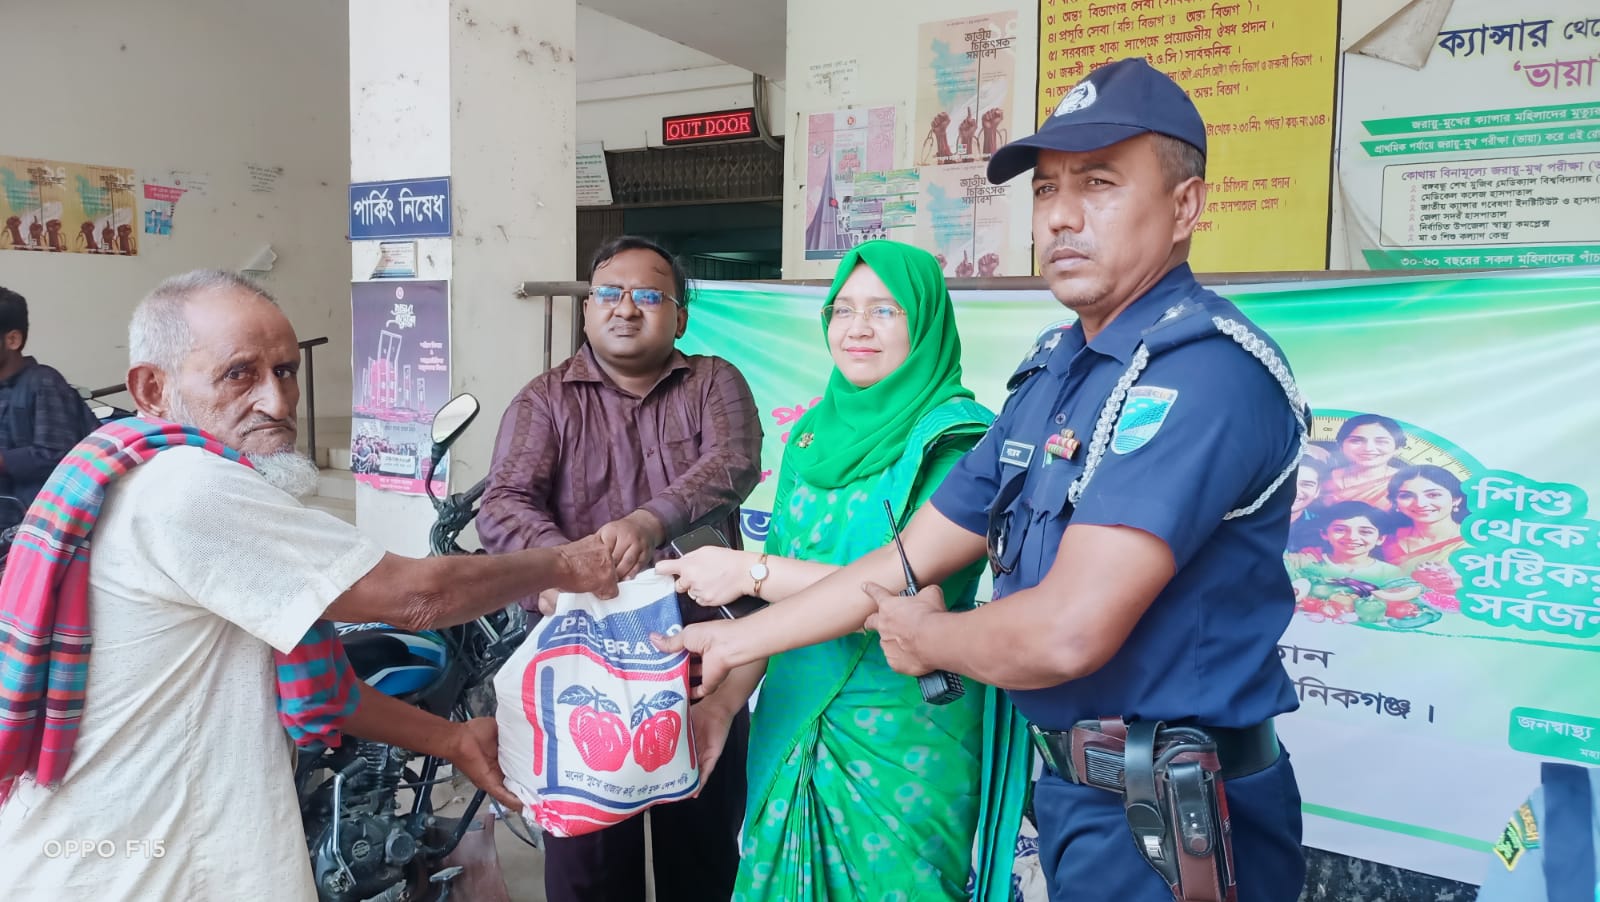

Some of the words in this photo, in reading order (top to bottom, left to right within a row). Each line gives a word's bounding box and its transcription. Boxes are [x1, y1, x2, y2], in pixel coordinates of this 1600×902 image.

[1059, 24, 1084, 42] প্রসূতি
[1087, 24, 1109, 37] সেবা
[1138, 14, 1164, 29] বিভাগ
[1212, 2, 1240, 18] বিভাগ
[1089, 3, 1126, 18] বিভাগের
[964, 28, 991, 41] জাতীয়
[971, 38, 1011, 51] চিকিৎসক
[1062, 45, 1095, 59] সরবরাহ
[1100, 42, 1119, 53] থাকা
[1124, 35, 1159, 49] সাপেক্ষে
[1164, 25, 1211, 44] প্রয়োজনীয়
[1241, 20, 1267, 33] প্রদান
[1438, 19, 1553, 57] ক্যান্সার
[966, 48, 998, 60] সমাবেশ
[1216, 80, 1240, 96] বিভাগ
[668, 121, 702, 138] OUT
[705, 114, 751, 134] DOOR
[1545, 132, 1564, 142] করে
[1401, 169, 1437, 181] কোথায়
[1440, 166, 1488, 180] বিনামূল্যে
[1547, 159, 1584, 173] পরীক্ষা
[353, 187, 396, 227] পার্কিং
[398, 187, 445, 224] নিষেধ
[1471, 477, 1572, 516] শিশু
[1470, 518, 1588, 549] থেকে
